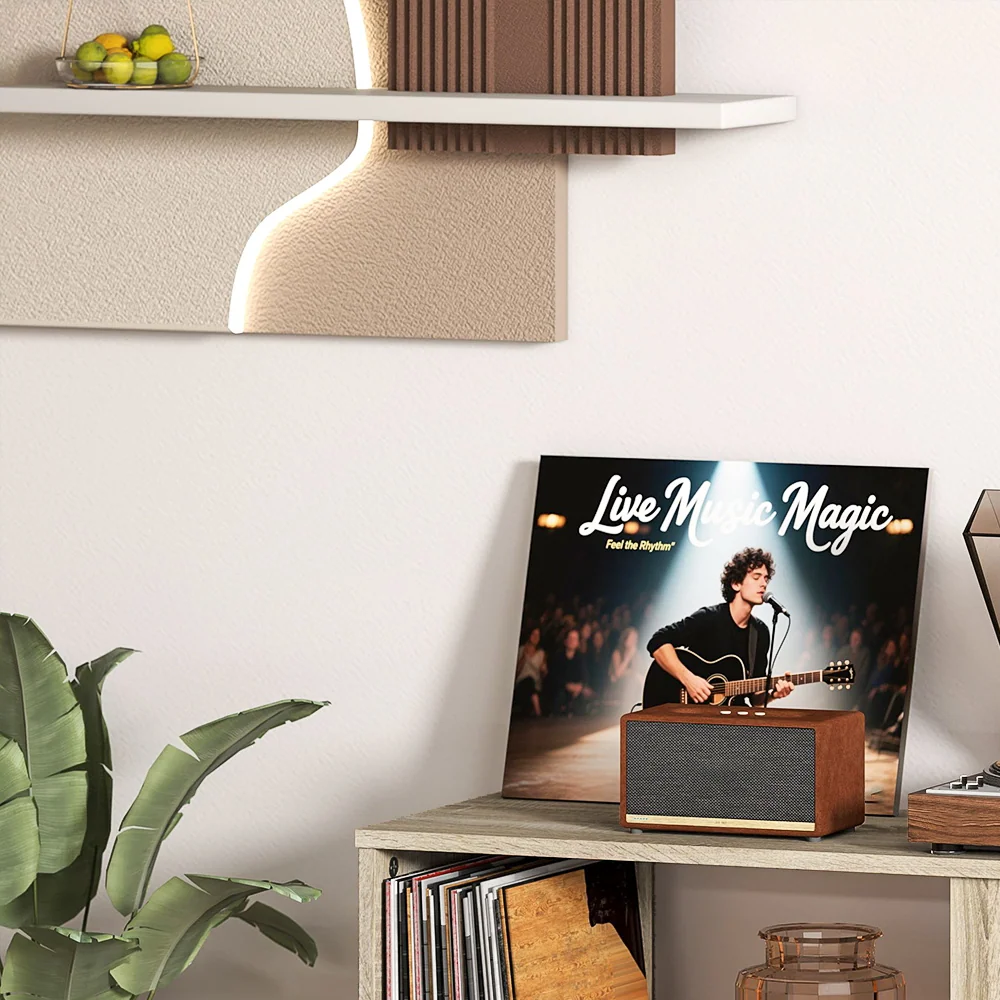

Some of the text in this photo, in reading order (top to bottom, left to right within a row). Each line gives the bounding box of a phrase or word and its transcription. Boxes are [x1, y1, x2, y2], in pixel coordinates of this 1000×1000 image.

[579, 474, 894, 556] Live Music Magic
[605, 539, 625, 549] Feel
[624, 540, 639, 550] the
